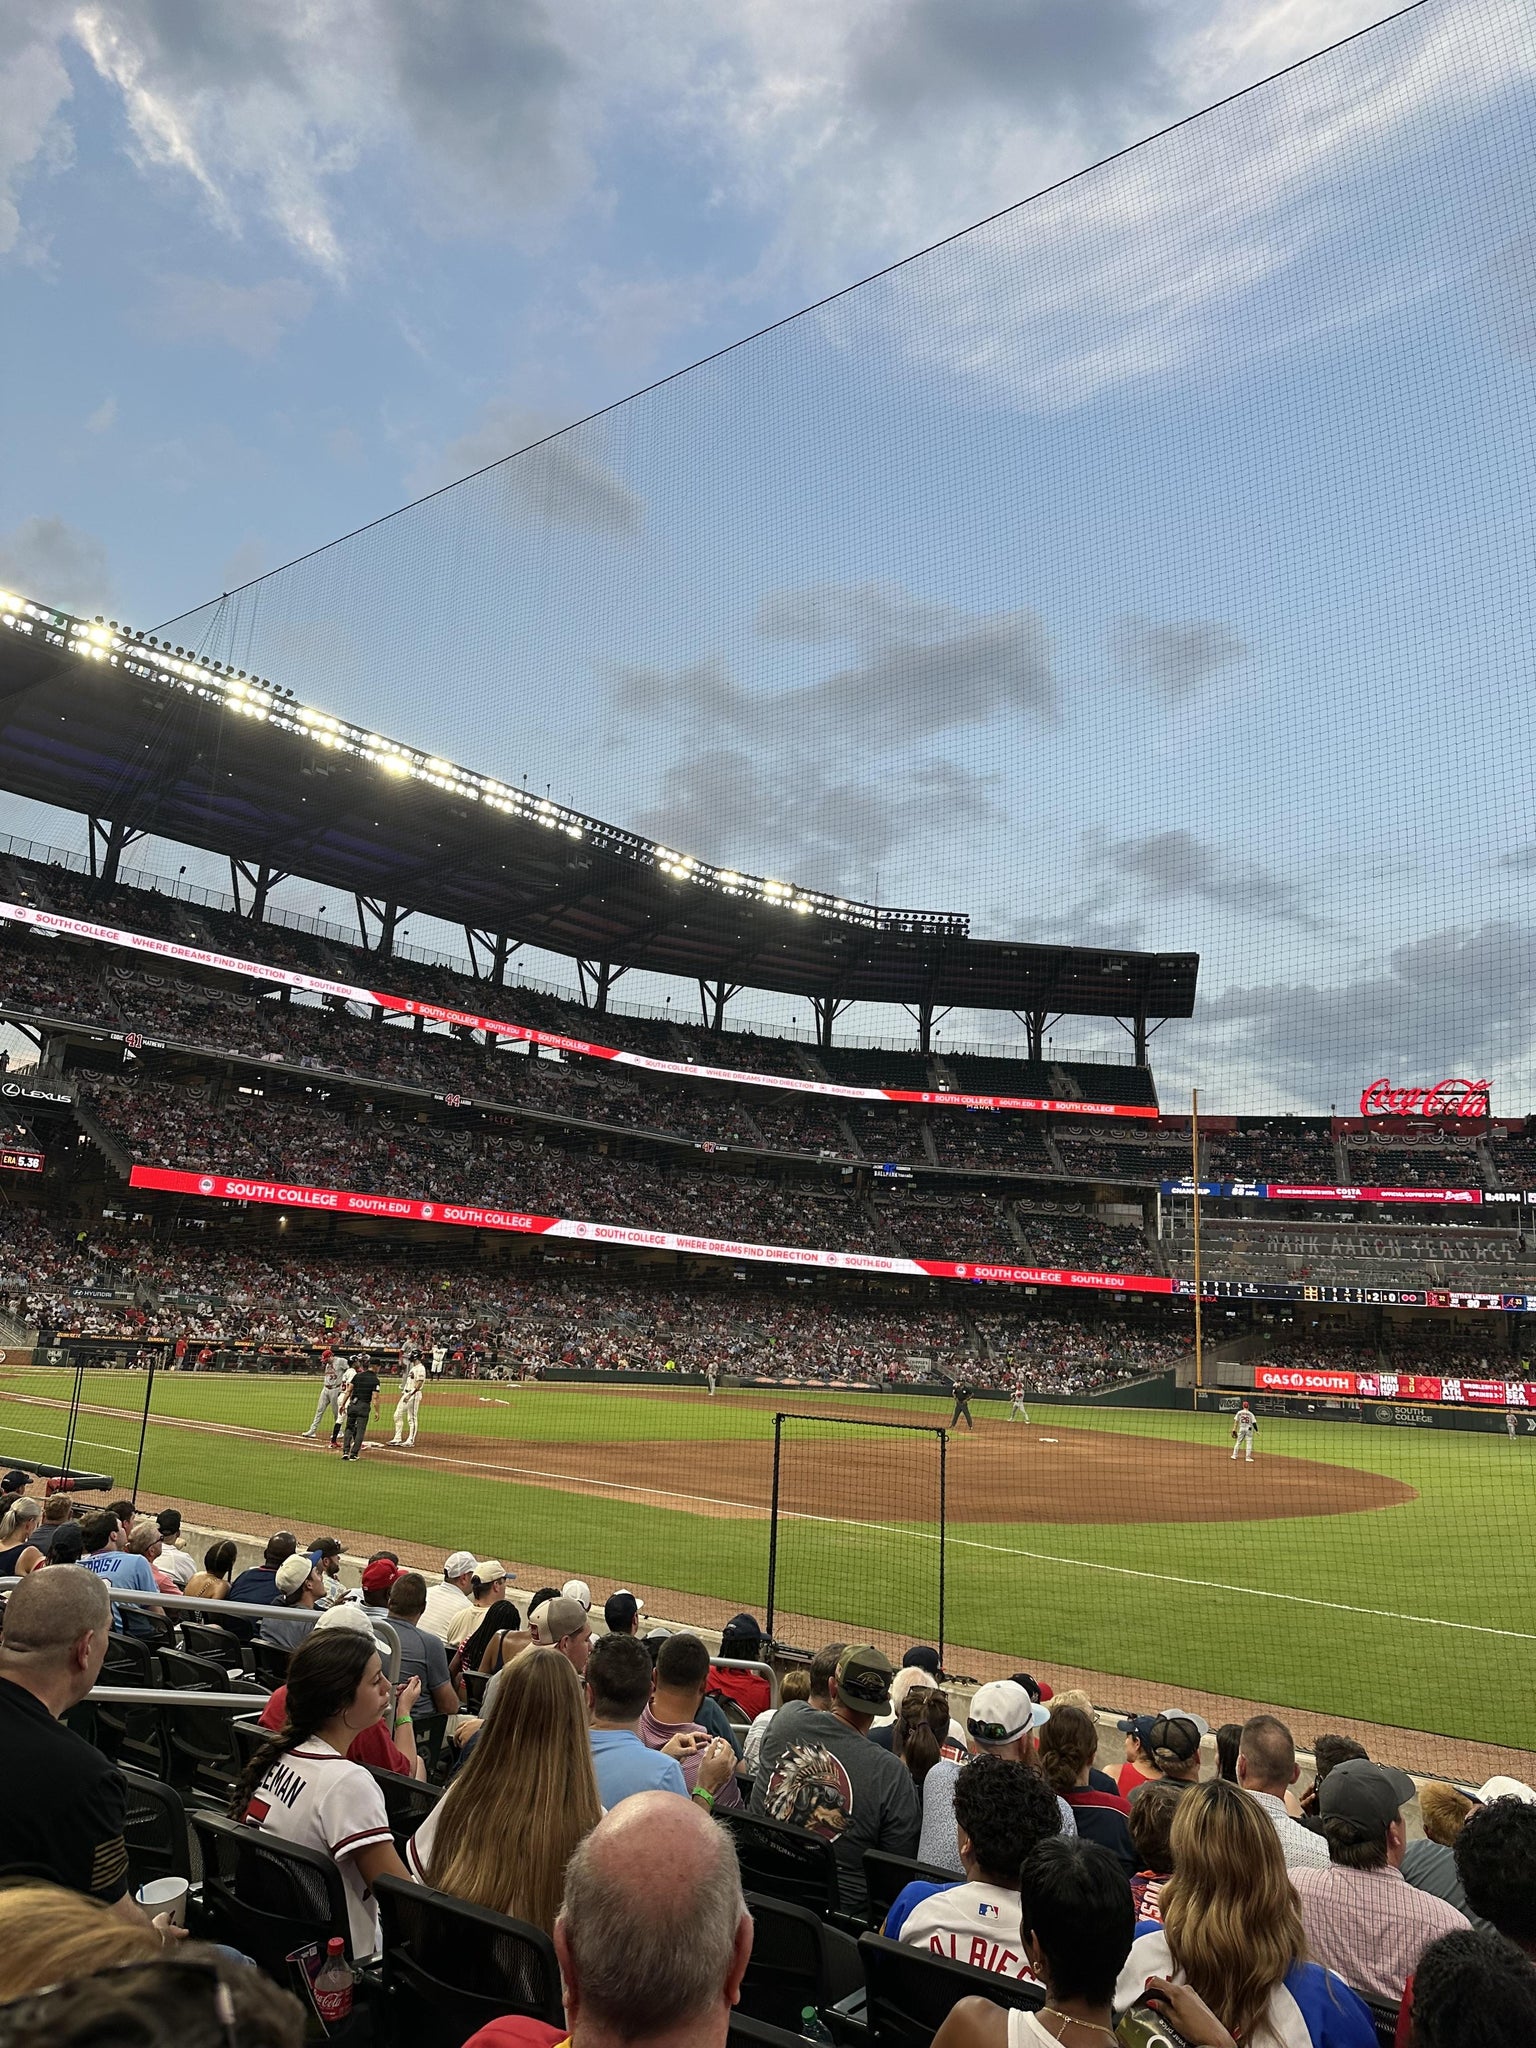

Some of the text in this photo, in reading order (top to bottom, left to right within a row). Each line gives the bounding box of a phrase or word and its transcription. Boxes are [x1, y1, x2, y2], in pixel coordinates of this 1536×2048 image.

[36, 913, 72, 929] SOUTH
[74, 923, 120, 940] COLLEGE
[132, 936, 169, 952] WHERE
[171, 946, 211, 961] DREAMS
[213, 956, 236, 968] FIND
[237, 962, 286, 979] DIRECTION
[419, 1006, 445, 1019] SOUTH
[446, 1012, 479, 1026] COLLEGE
[537, 1034, 561, 1044] SOUTH
[562, 1038, 589, 1051] COLLEGE
[125, 1033, 143, 1048] 41
[645, 1059, 666, 1072] SOUTH
[667, 1062, 698, 1074] COLLEGE
[706, 1069, 731, 1079] WHERE
[733, 1072, 761, 1082] DREAMS
[762, 1075, 778, 1085] FIND
[780, 1078, 814, 1090] DIRECTION
[21, 1088, 71, 1103] LEXUS
[445, 1093, 460, 1107] 44
[1360, 1078, 1494, 1118] Coca-Cola
[935, 1095, 960, 1104] SOUTH
[961, 1097, 994, 1105] COLLEGE
[1056, 1102, 1081, 1112] SOUTH
[1082, 1104, 1114, 1113] COLLEGE
[702, 1141, 716, 1153] 47
[3, 1155, 16, 1165] ERA
[1506, 1193, 1520, 1201] PM
[225, 1182, 532, 1228] SOUTH COLLEGE SOUTH.EDU SOUTH COLLEGE
[594, 1227, 892, 1269] SOUTH COLLEGE WHERE DREAMS FIND DIRECTION SOUTH.EDU
[1267, 1235, 1516, 1261] HANK AARON TERRACE
[974, 1267, 1124, 1286] SOUTH COLLEGE SOUTH.EDU
[1372, 1293, 1379, 1301] 2
[1389, 1293, 1396, 1302] 0
[1467, 1300, 1480, 1308] 90
[1263, 1373, 1348, 1388] GAS SOUTH
[1359, 1379, 1376, 1390] AL
[1380, 1375, 1398, 1384] MIN
[1506, 1383, 1525, 1392] LAA
[1395, 1414, 1432, 1423] COLLEGE
[111, 1560, 121, 1572] II
[260, 1761, 306, 1809] EMAN
[1159, 2018, 1173, 2034] price
